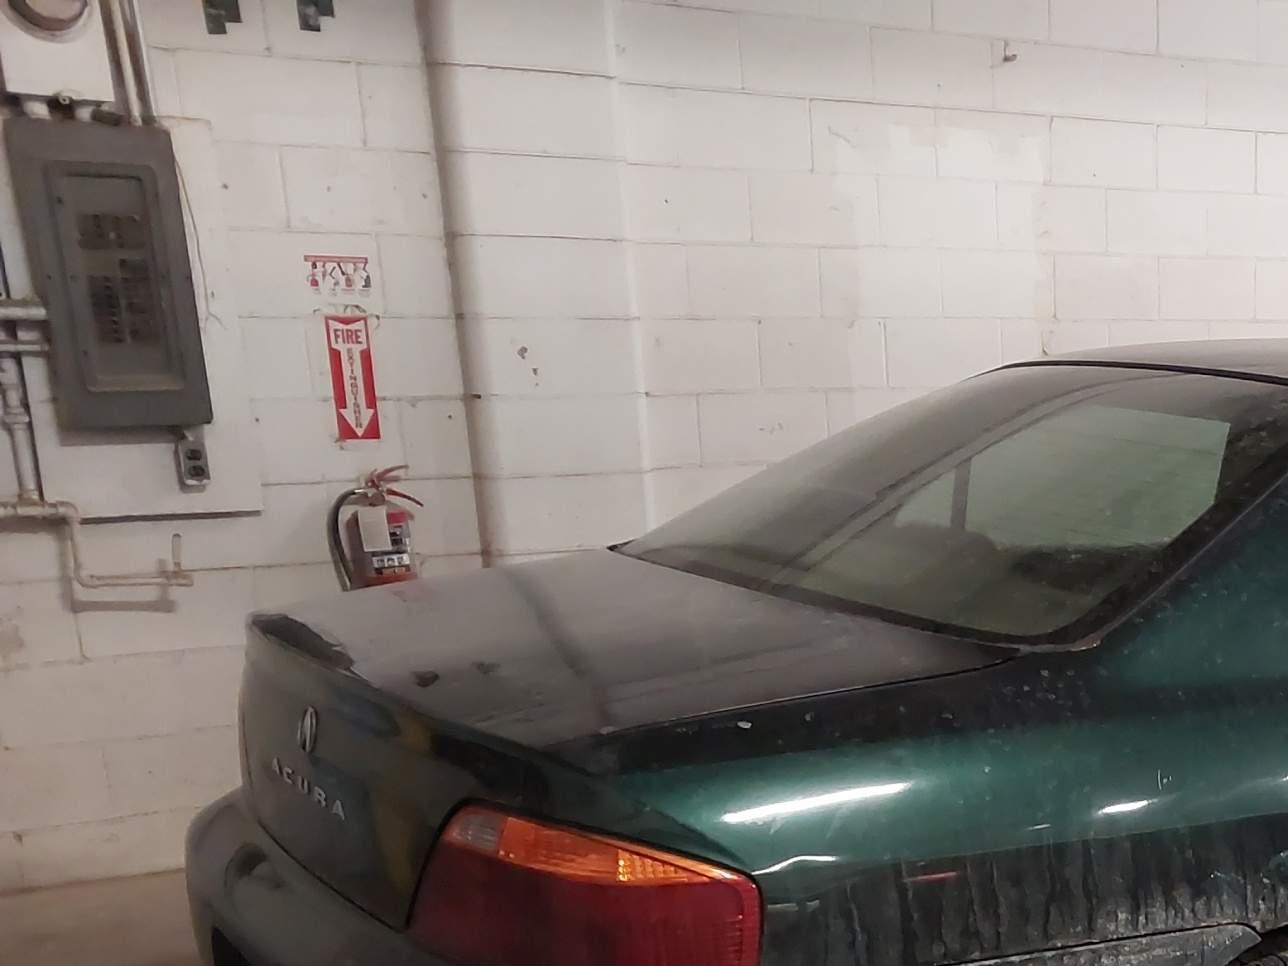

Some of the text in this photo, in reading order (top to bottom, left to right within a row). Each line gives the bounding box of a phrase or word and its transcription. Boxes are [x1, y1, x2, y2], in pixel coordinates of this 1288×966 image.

[333, 328, 363, 345] FIRE
[346, 348, 363, 429] EXTINGUISHER
[271, 756, 345, 821] ACURA
